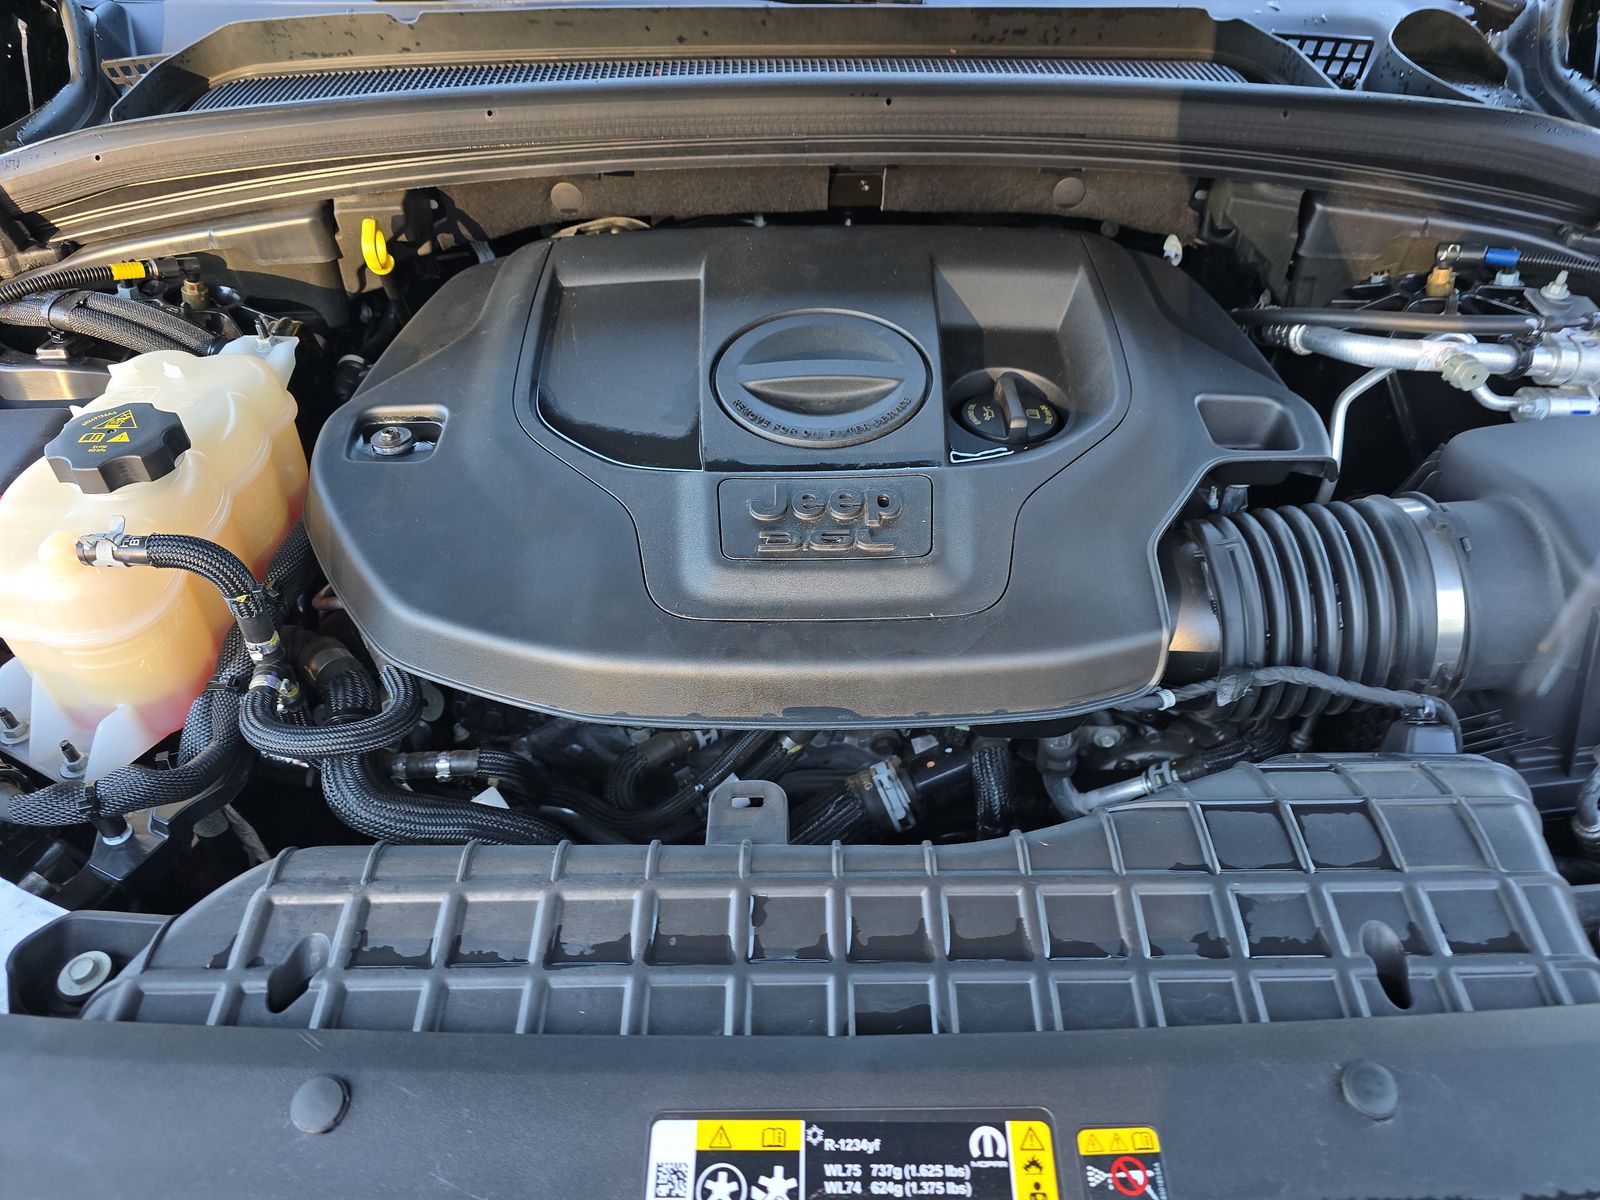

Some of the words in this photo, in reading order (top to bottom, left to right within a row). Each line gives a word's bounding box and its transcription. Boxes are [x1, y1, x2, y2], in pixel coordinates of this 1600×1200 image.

[732, 398, 771, 428] REMOVE
[772, 422, 798, 437] FOR
[803, 429, 823, 440] OIL
[829, 423, 872, 439] FILTER
[872, 397, 912, 428] SERVICE
[749, 482, 902, 527] Jeep
[757, 529, 896, 552] 3.6L
[823, 1138, 882, 1155] R-1234yf
[823, 1163, 863, 1177] WL75
[869, 1163, 903, 1180] 737g
[904, 1163, 944, 1180] (1.625
[944, 1163, 972, 1180] lbs)
[823, 1181, 863, 1195] WL74
[870, 1181, 904, 1198] 624g
[904, 1181, 945, 1198] (1.375
[945, 1181, 973, 1198] lbs)
